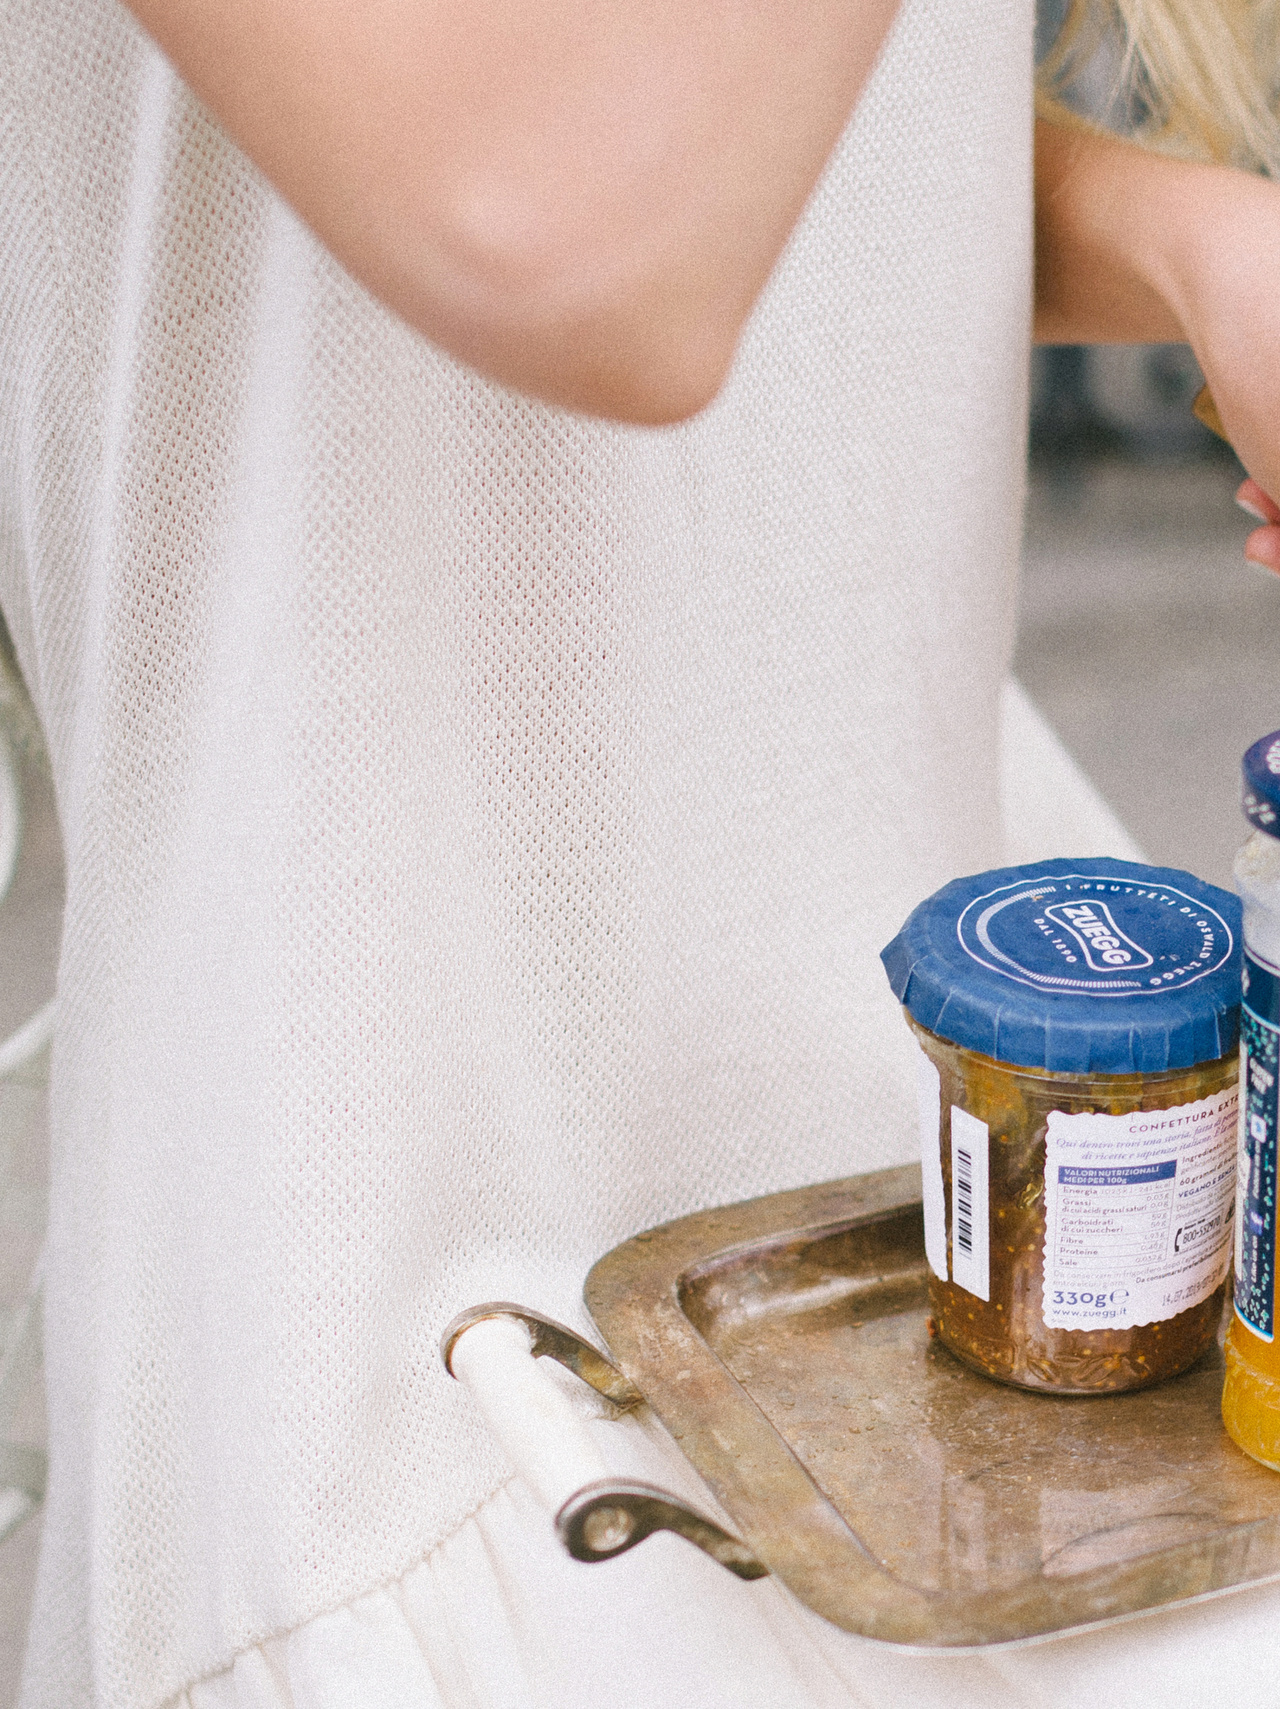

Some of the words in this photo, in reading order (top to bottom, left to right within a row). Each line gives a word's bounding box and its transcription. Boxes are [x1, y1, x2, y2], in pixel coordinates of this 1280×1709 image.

[1061, 904, 1132, 965] ZUEGG
[1033, 918, 1054, 937] DAL
[1051, 938, 1078, 964] 1890
[1129, 1109, 1214, 1134] CONFETTURA
[1079, 1139, 1114, 1149] dentro
[1064, 1168, 1097, 1177] VALORI
[1098, 1165, 1160, 1177] NUTRIZIONALI
[1063, 1176, 1086, 1184] MEDI
[1087, 1176, 1105, 1184] PER
[1063, 1186, 1098, 1196] Energia
[1179, 1181, 1212, 1198] VEGANO
[1062, 1197, 1092, 1207] Grassi
[1061, 1217, 1114, 1226] Carboidrati
[1060, 1236, 1084, 1245] Fibre
[1060, 1246, 1098, 1256] Proteine
[1059, 1258, 1078, 1266] Sale
[1053, 1290, 1107, 1308] 330g
[1053, 1307, 1127, 1319] www.zuegg.it
